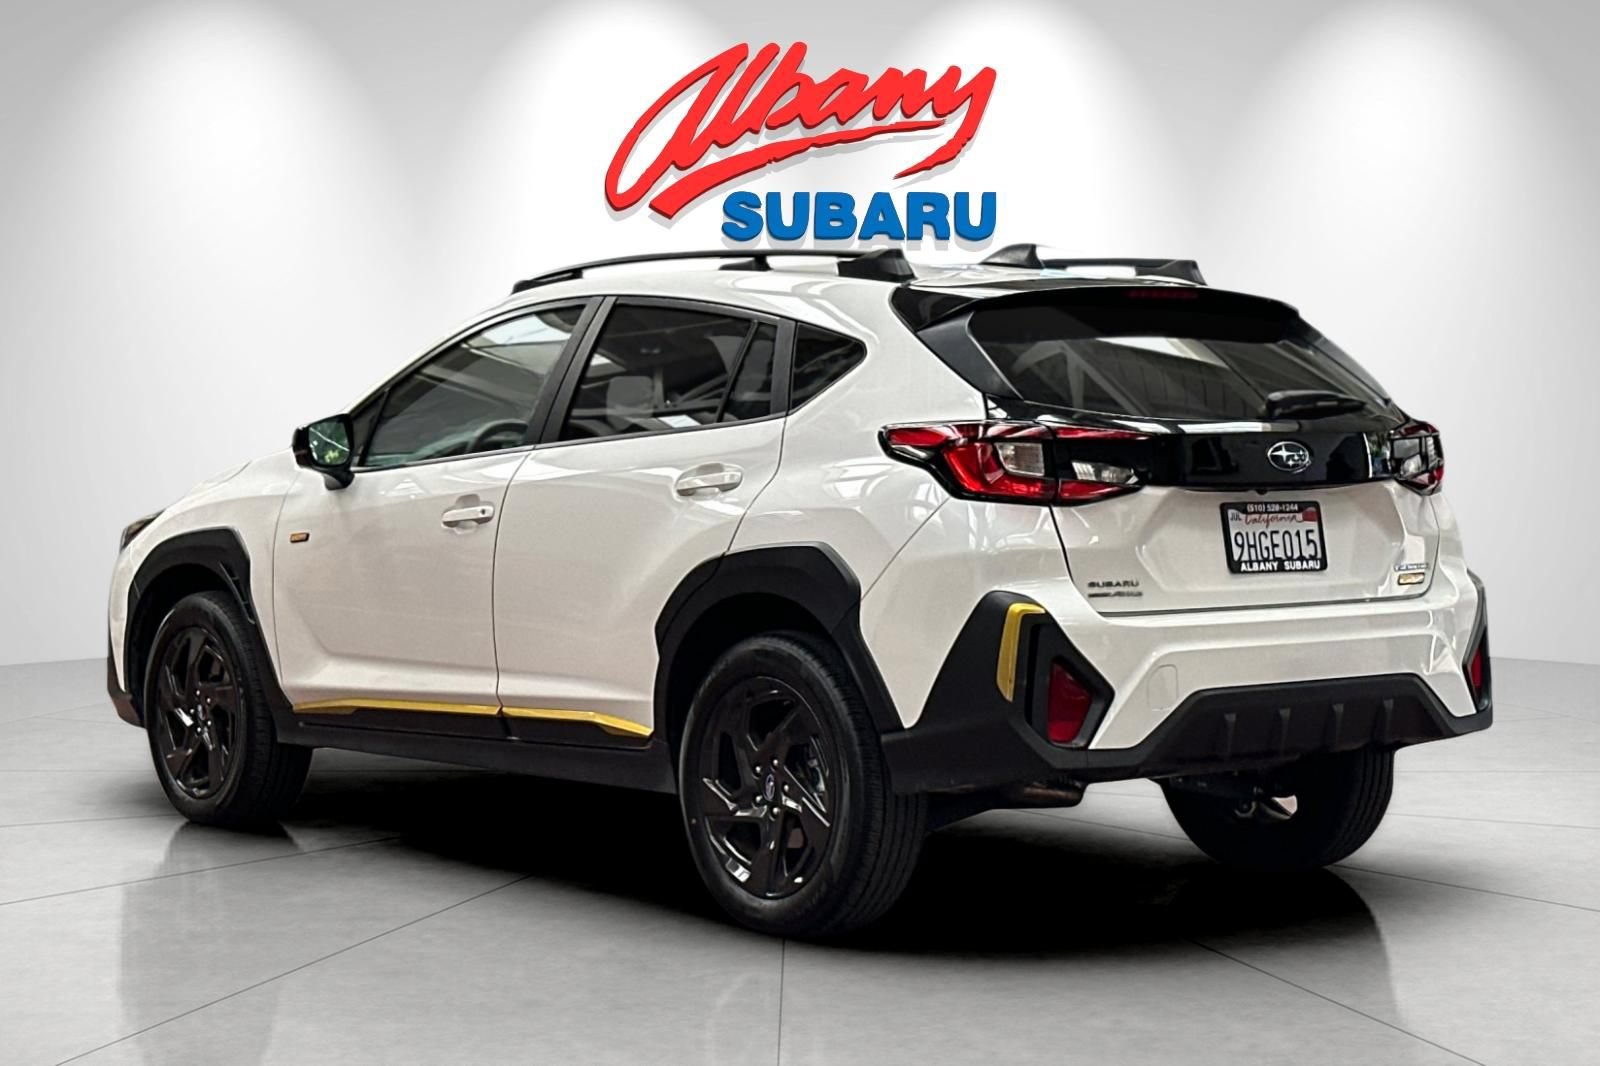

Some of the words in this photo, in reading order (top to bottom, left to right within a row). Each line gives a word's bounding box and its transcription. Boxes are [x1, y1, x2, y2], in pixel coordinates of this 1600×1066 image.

[604, 41, 997, 211] Albany
[721, 191, 997, 242] SUBARU
[1247, 504, 1265, 512] (510)
[1234, 529, 1318, 561] 9HGE015
[1240, 561, 1278, 572] ALBANY
[1284, 560, 1321, 570] SUBARU
[1087, 580, 1139, 588] SUBARU
